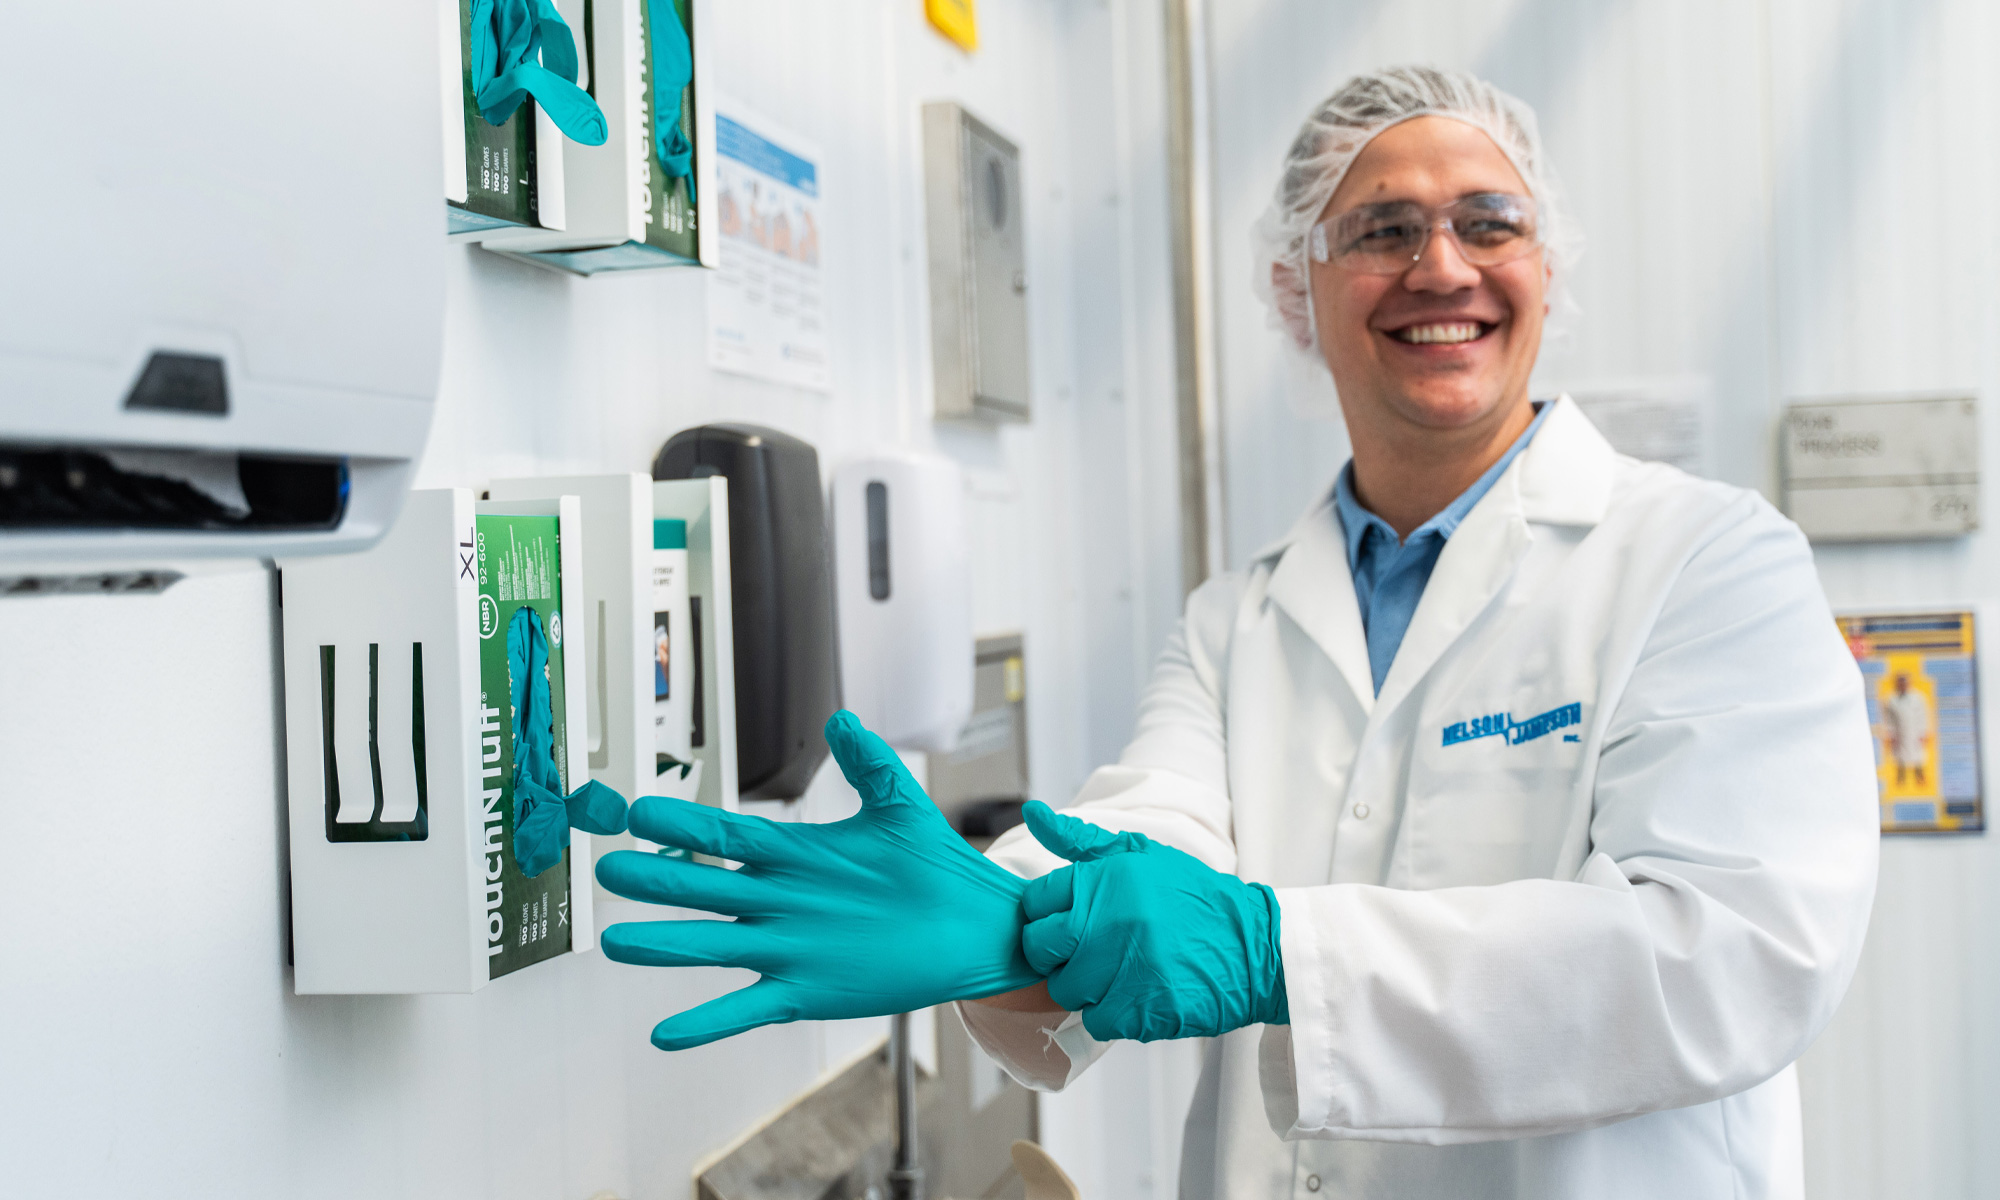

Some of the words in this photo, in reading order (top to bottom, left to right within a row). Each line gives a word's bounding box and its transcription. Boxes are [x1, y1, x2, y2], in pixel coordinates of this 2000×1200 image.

[519, 171, 528, 185] L
[460, 527, 474, 580] XL
[478, 533, 487, 584] 92-600
[482, 601, 490, 631] NBR
[1442, 713, 1504, 744] NELSON
[1512, 704, 1580, 745] JAMESON
[558, 891, 568, 928] XL
